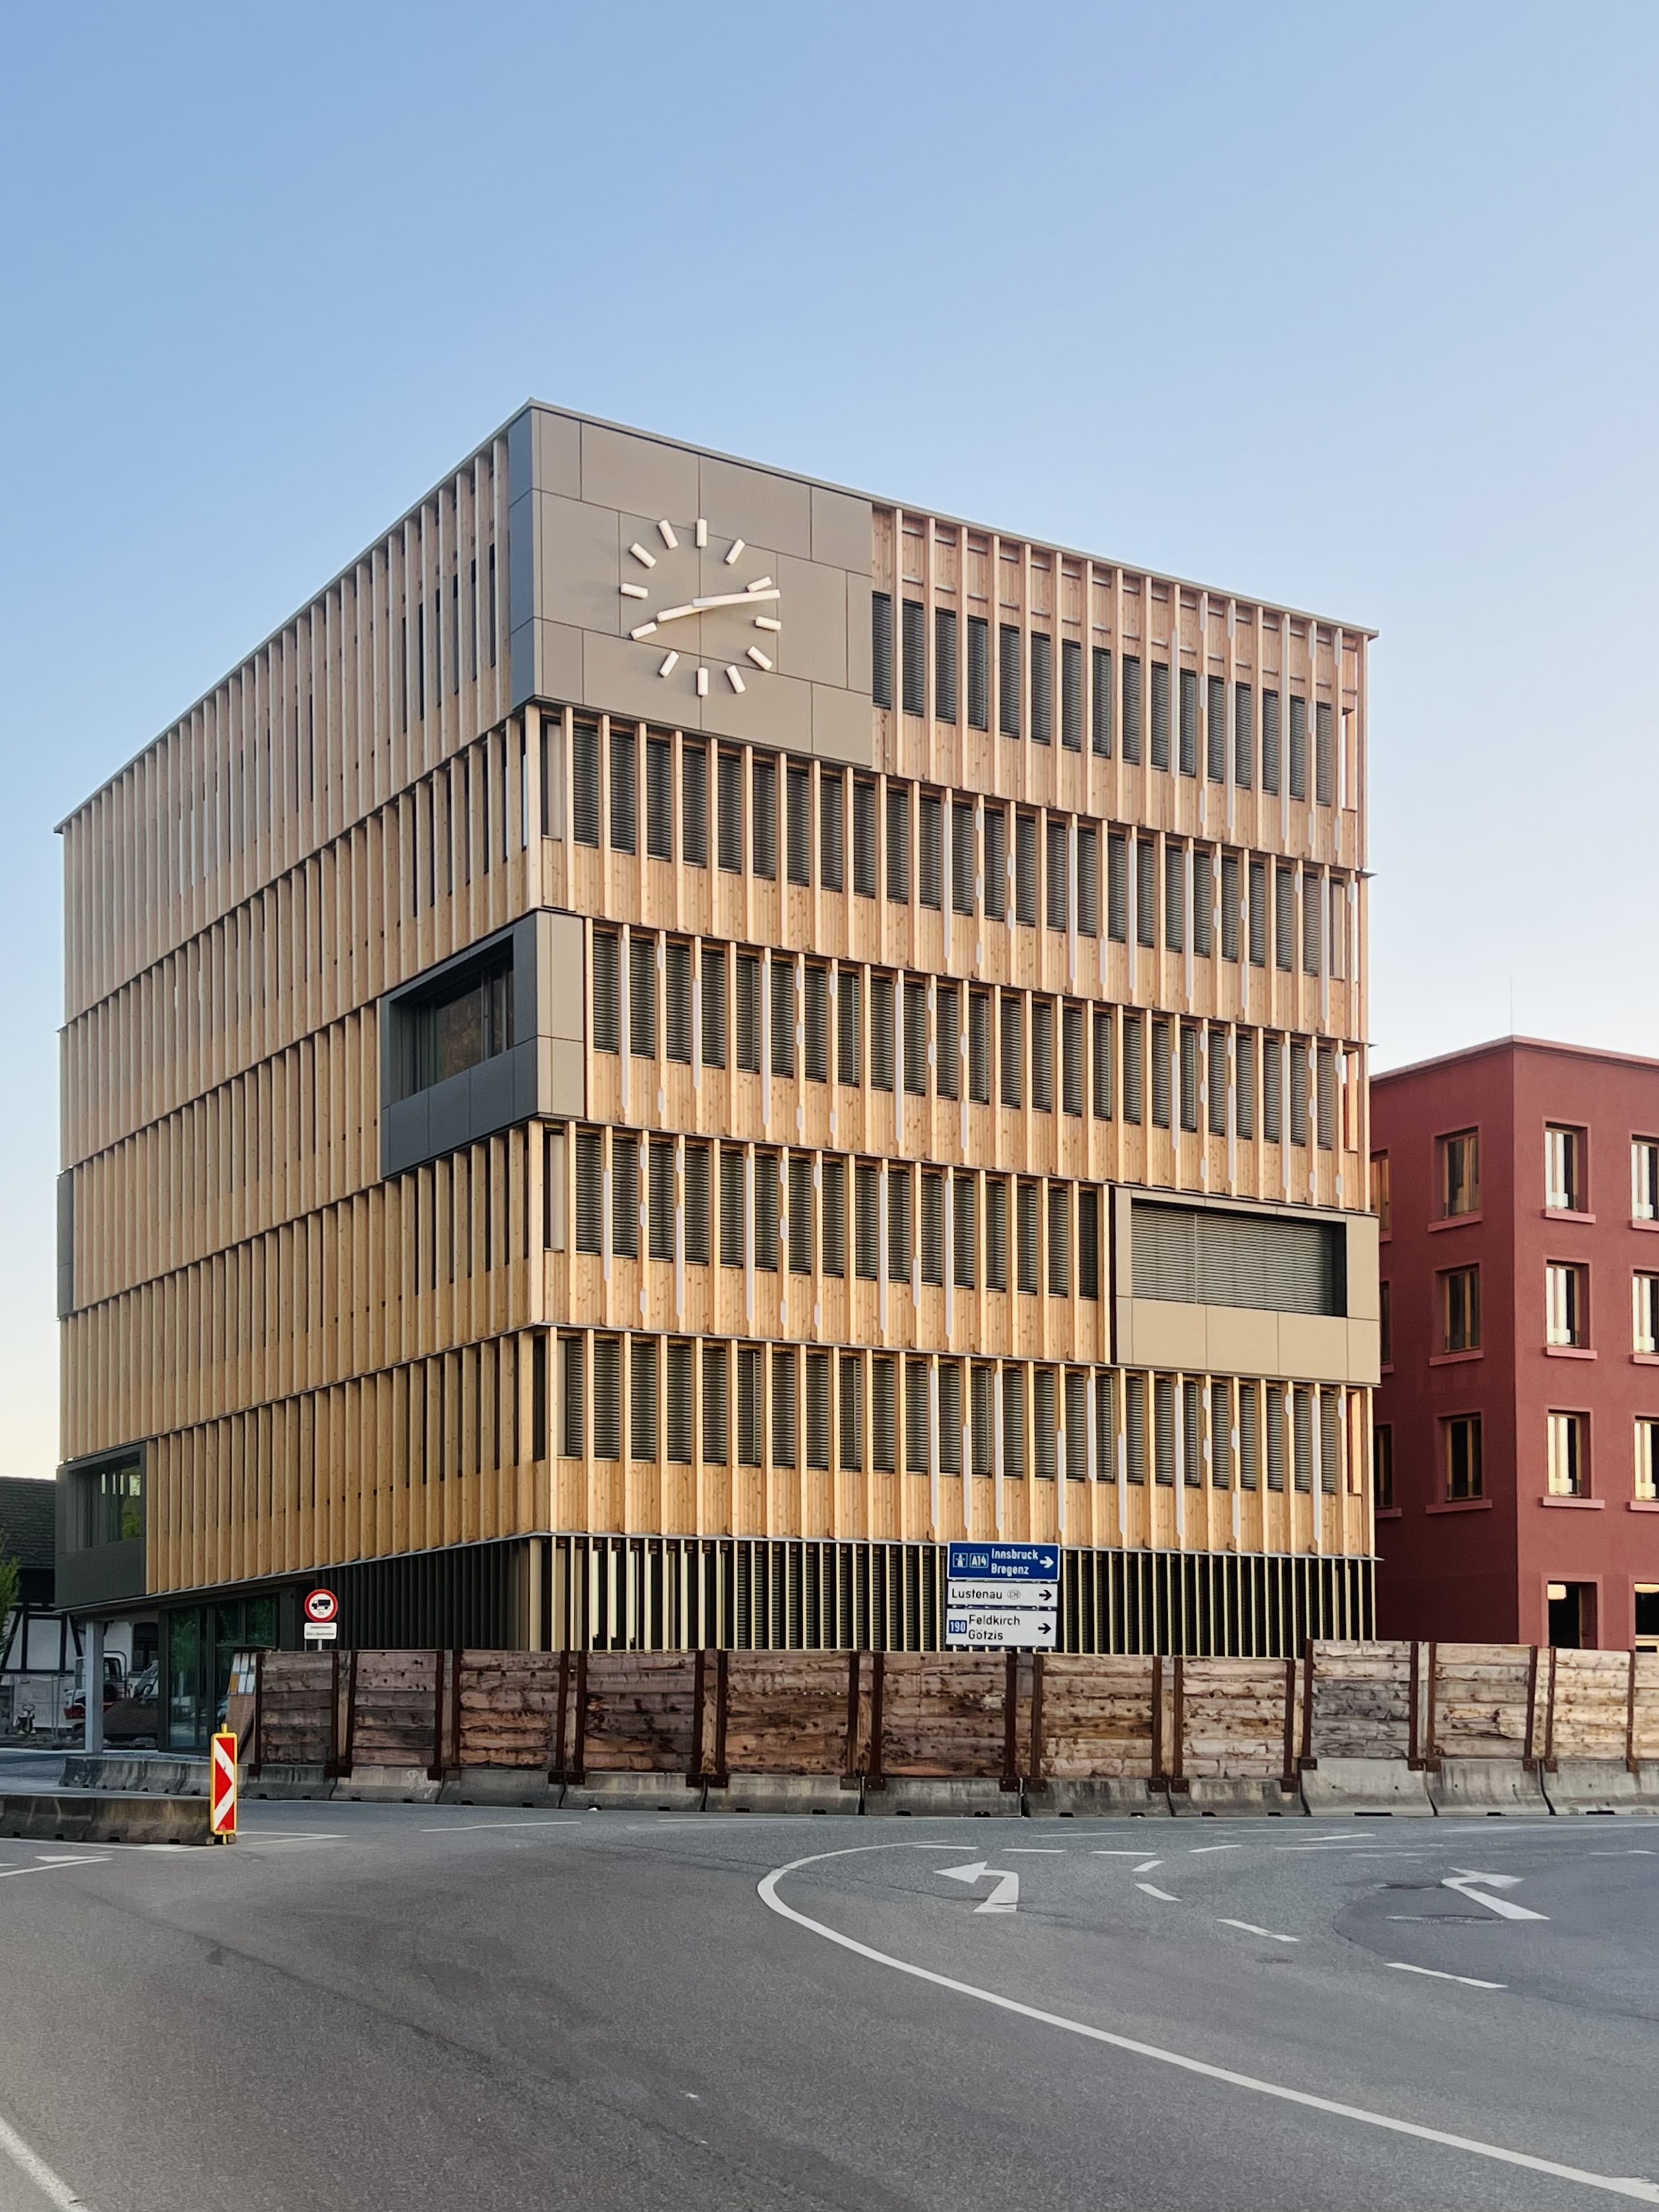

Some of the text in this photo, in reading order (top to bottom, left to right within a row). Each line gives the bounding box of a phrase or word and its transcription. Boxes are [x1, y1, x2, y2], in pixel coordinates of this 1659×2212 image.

[991, 1548, 1038, 1560] Innsbruck
[971, 1556, 987, 1566] A14
[991, 1563, 1029, 1577] Bregenz
[952, 1588, 1003, 1599] Lustenau
[969, 1614, 1020, 1626] Feldkirch
[950, 1621, 966, 1633] 190
[968, 1629, 1003, 1640] Götzis
